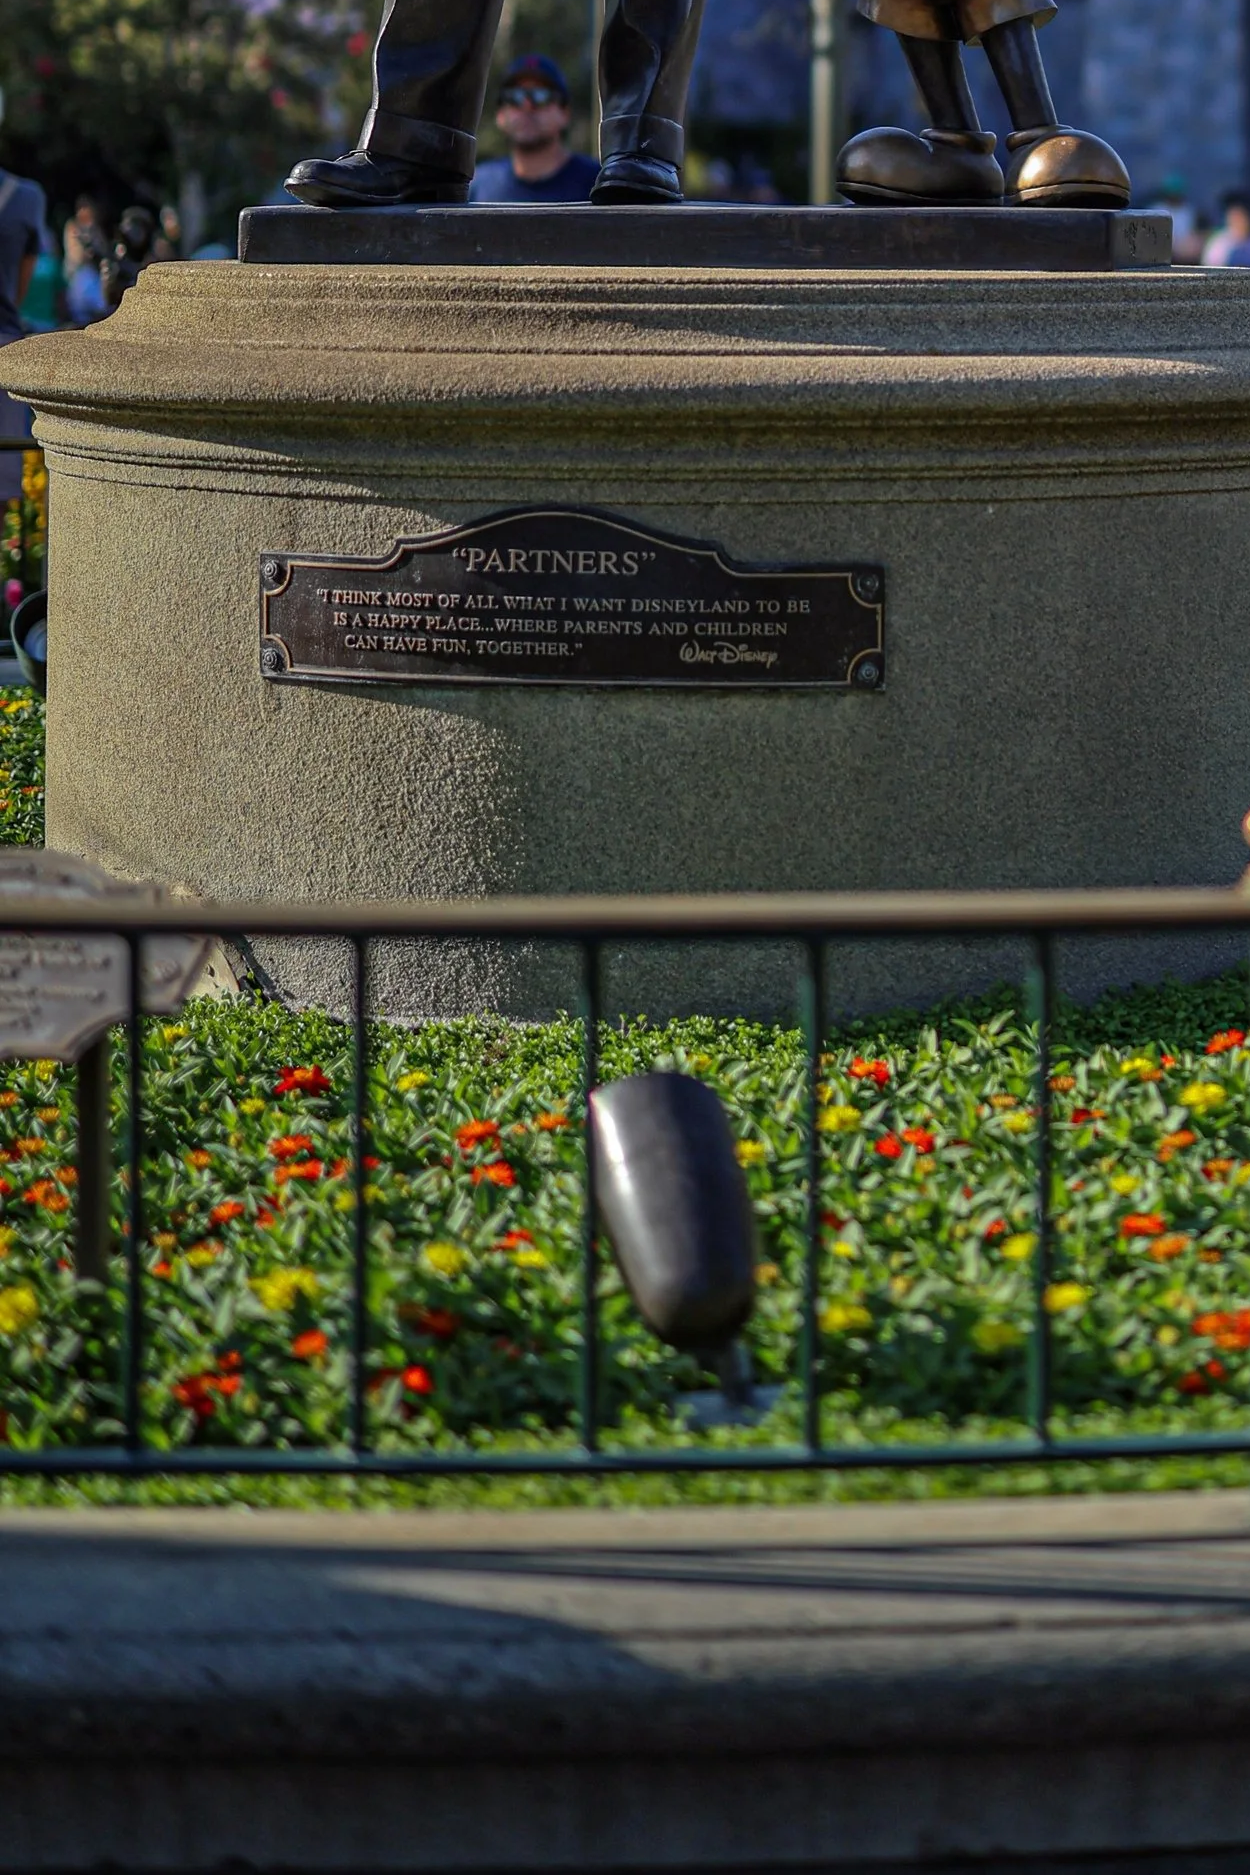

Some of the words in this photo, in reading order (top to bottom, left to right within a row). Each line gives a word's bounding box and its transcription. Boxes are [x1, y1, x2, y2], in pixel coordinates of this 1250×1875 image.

[452, 547, 656, 575] “PARTNERS”
[332, 589, 382, 604] THINK
[386, 591, 433, 607] MOST
[438, 593, 460, 608] OF
[464, 594, 499, 609] ALL
[503, 595, 556, 610] WHAT
[560, 597, 567, 611] I
[573, 597, 625, 612] WANT
[631, 598, 750, 613] DISNEYLAND
[756, 599, 780, 614] TO
[787, 599, 810, 613] BE
[333, 611, 347, 625] IS
[352, 613, 362, 627] A
[368, 613, 422, 629] HAPPY
[564, 620, 643, 635] PARENTS
[649, 621, 688, 635] AND
[694, 621, 788, 636] CHILDREN
[344, 634, 378, 649] CAN
[383, 636, 427, 651] HAVE
[432, 638, 471, 655] FUN,
[476, 640, 583, 656] TOGETHER.”
